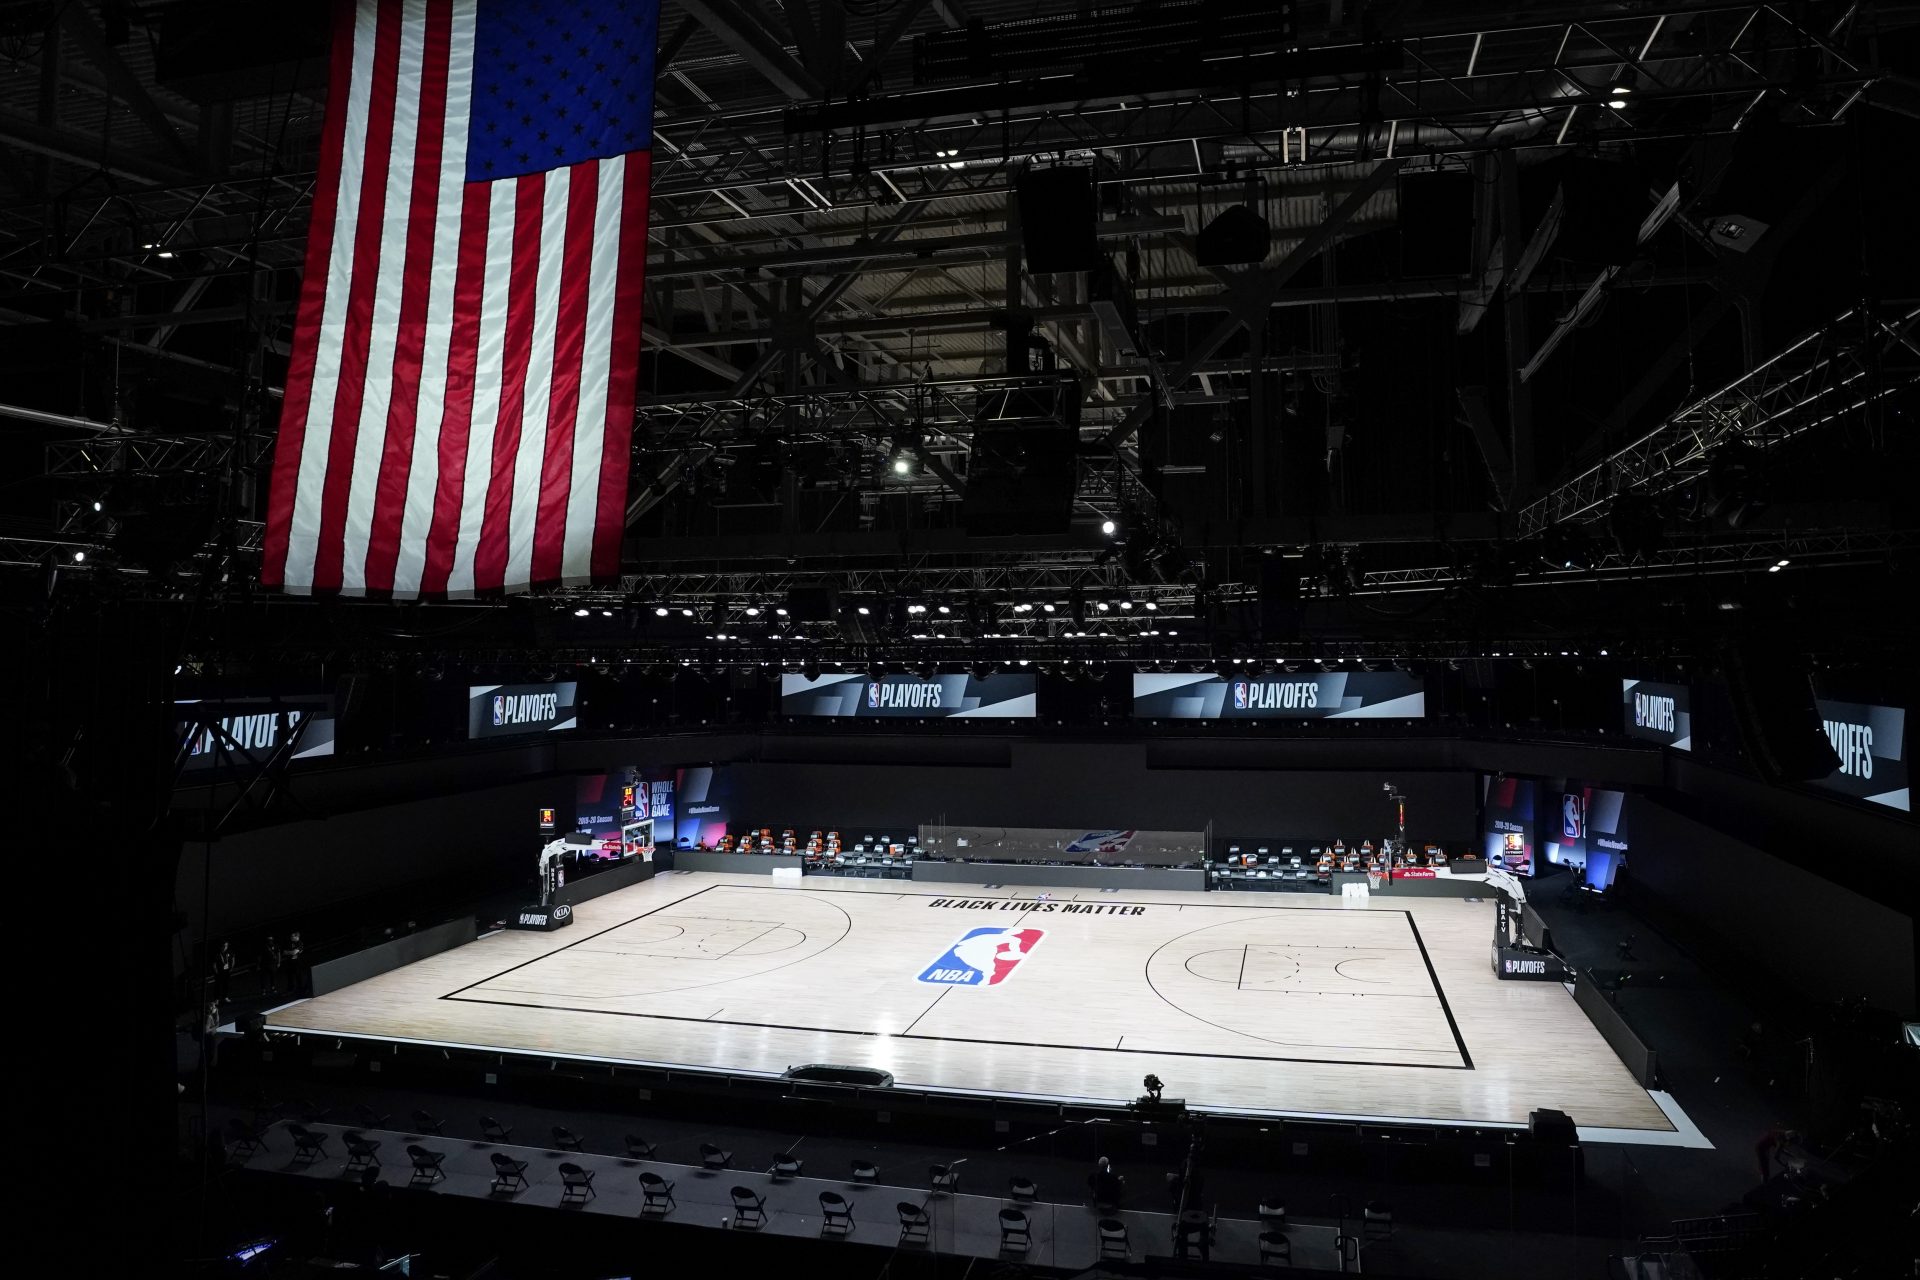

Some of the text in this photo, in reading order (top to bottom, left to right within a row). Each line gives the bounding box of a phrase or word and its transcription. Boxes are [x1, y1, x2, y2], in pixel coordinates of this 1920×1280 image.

[880, 683, 943, 708] PLAYOFFS
[1248, 682, 1319, 709] PLAYOFFS
[504, 693, 557, 724] PLAYOFFS
[1641, 694, 1675, 733] PLAYOFFS
[651, 781, 673, 793] WHOLE
[651, 792, 667, 805] NEW
[651, 804, 670, 818] GAME
[596, 815, 613, 824] Season
[556, 907, 569, 918] KIA
[928, 898, 1146, 916] BLACK LIVES MATTER
[523, 913, 548, 926] PLAYOFFS
[1500, 921, 1506, 933] TV
[1512, 960, 1545, 974] PLAYOFFS
[926, 968, 975, 983] NBA
